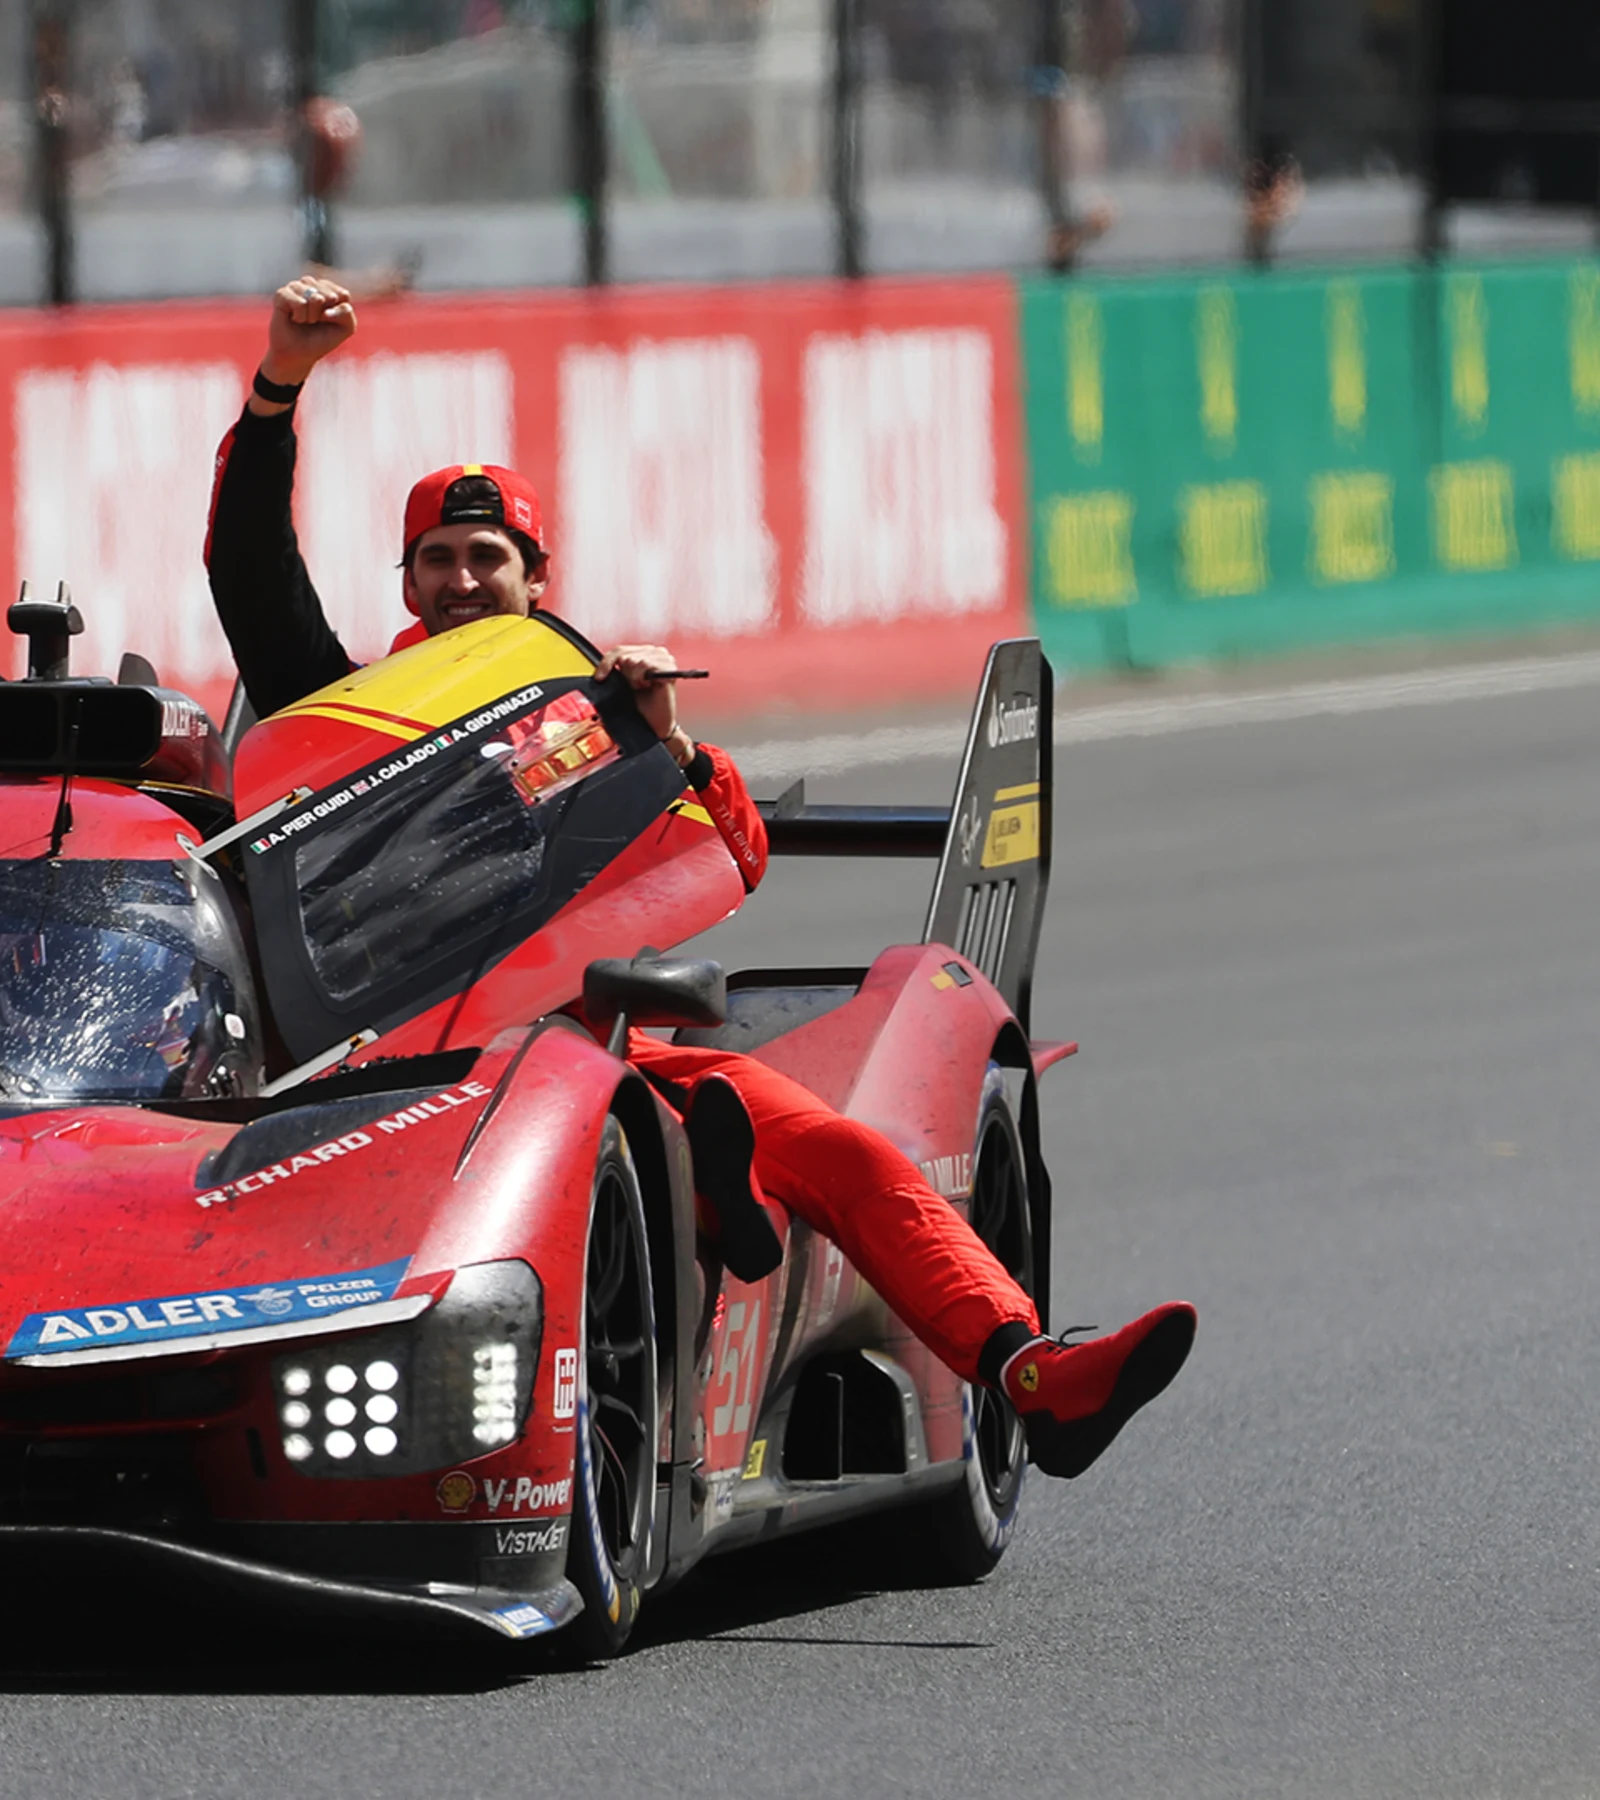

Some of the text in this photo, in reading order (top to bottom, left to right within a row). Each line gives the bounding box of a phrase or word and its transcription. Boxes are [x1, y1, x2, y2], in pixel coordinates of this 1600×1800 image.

[268, 686, 544, 847] A. PIER GUIDI J. CALADO A. GIOVINAZZI
[195, 1080, 493, 1209] RICHARD MILLE
[38, 1294, 245, 1345] ADLER
[713, 1299, 761, 1437] 51
[483, 1477, 571, 1512] V-Power
